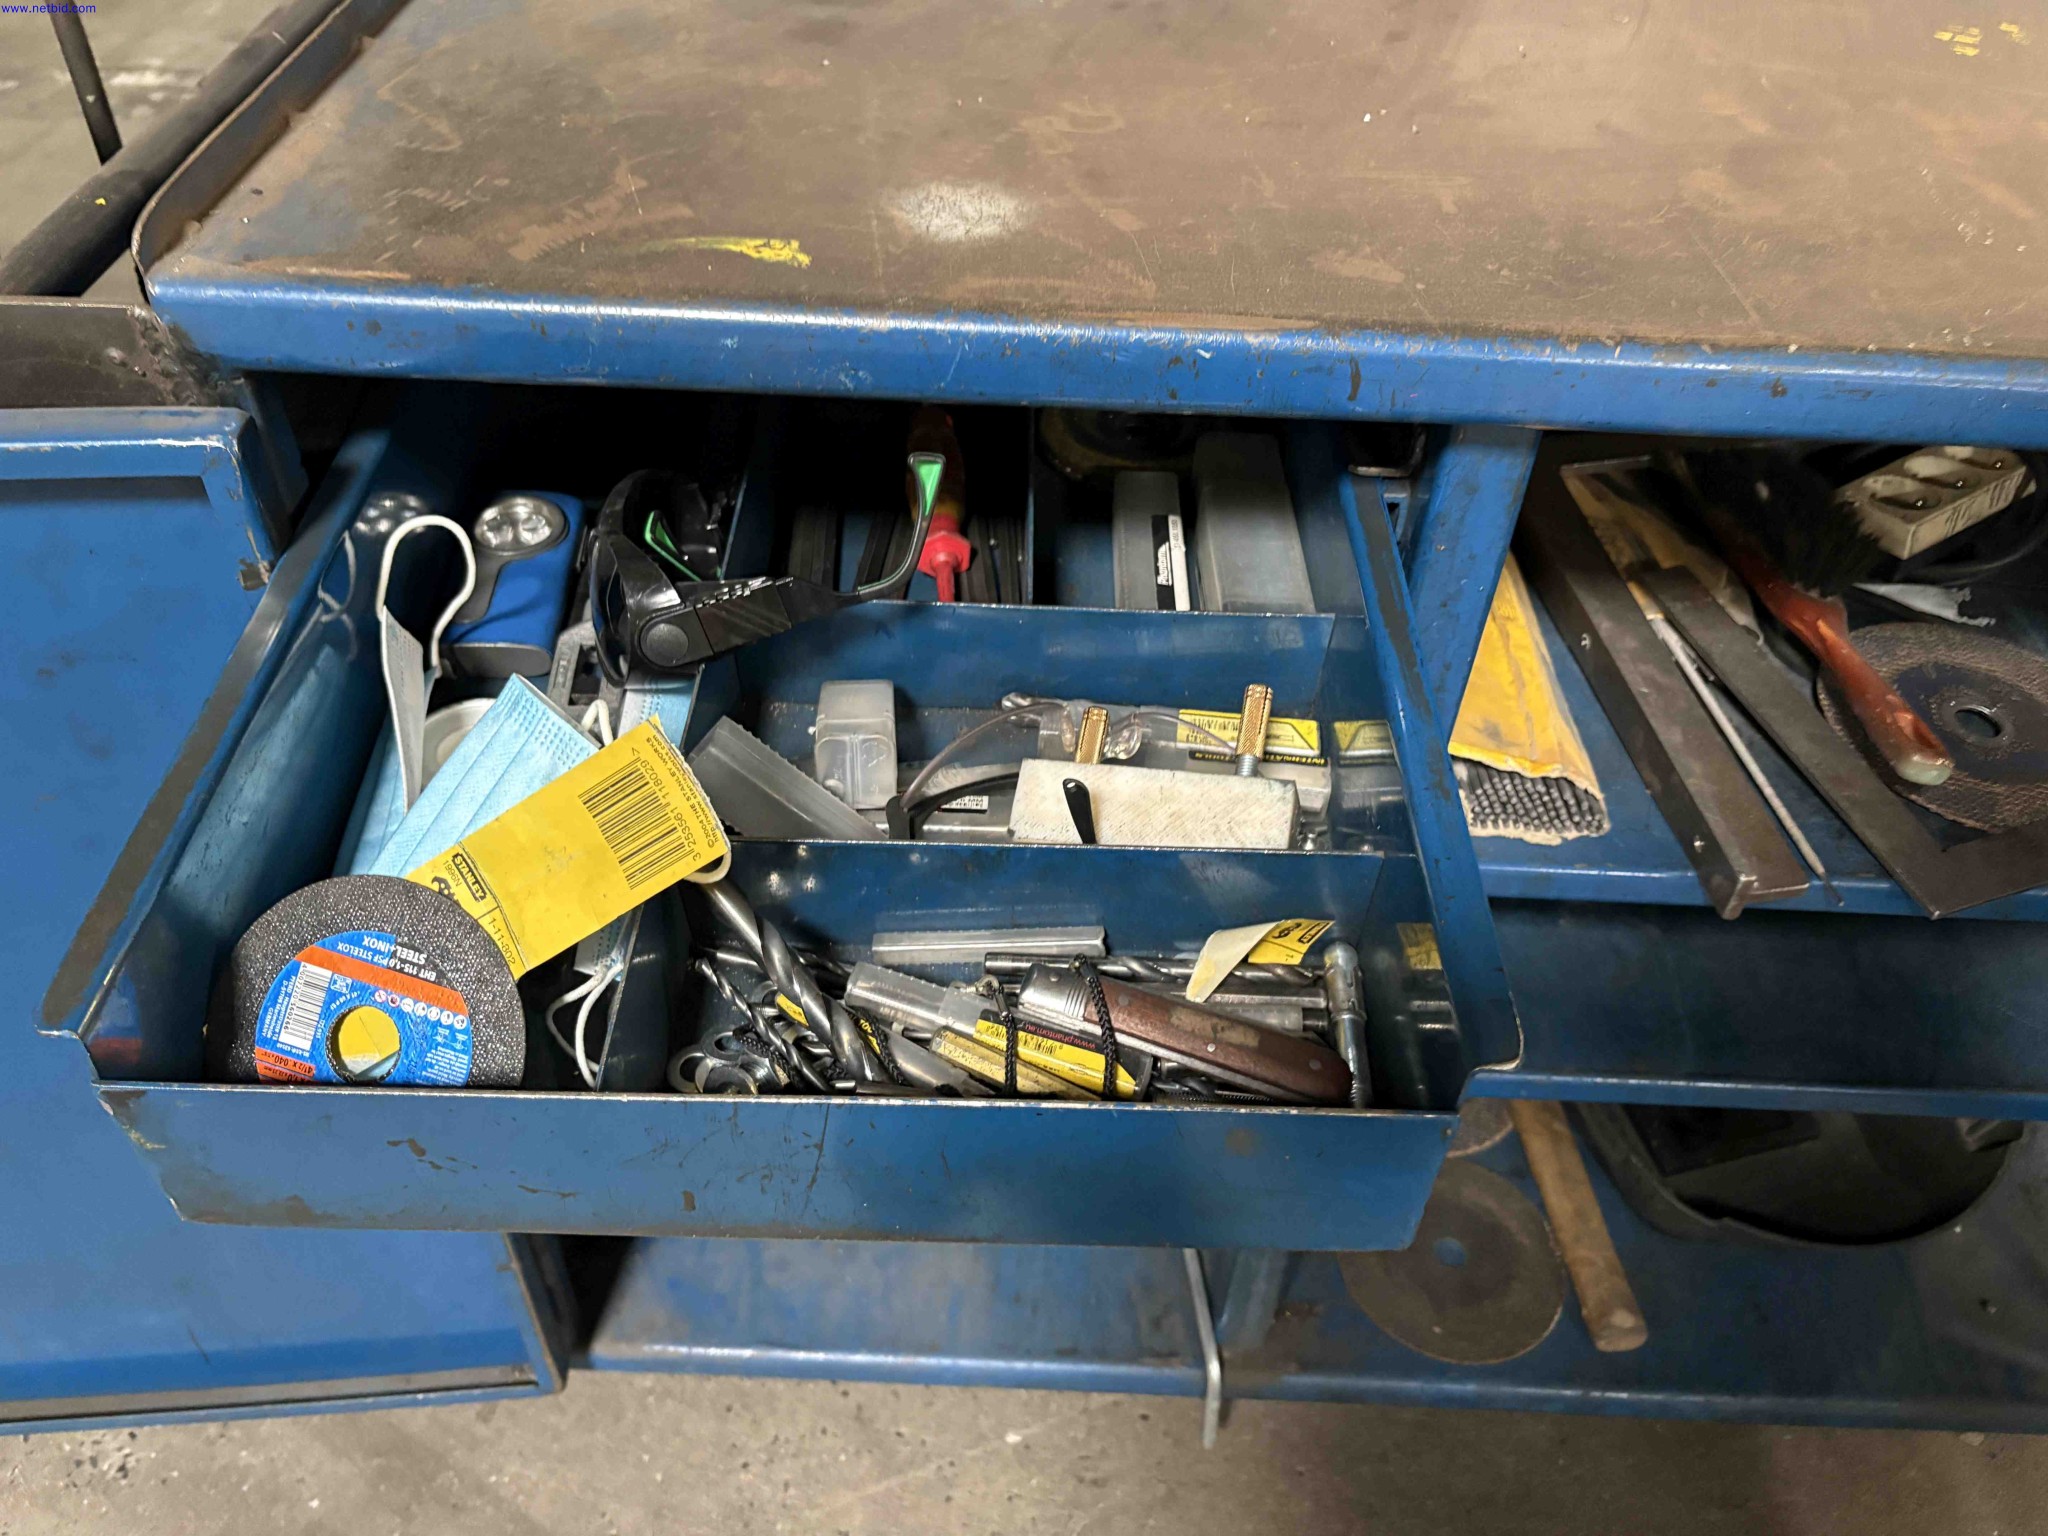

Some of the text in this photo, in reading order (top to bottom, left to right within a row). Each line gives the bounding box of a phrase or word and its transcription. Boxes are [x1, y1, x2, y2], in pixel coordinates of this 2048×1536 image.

[645, 734, 669, 767] WORKS
[665, 765, 692, 802] STANLEY
[639, 757, 702, 862] 3 253561 118029
[441, 859, 462, 887] 1996N
[452, 853, 485, 899] STANLEY
[336, 941, 373, 959] STEELOX
[361, 935, 427, 963] STEEL+INOX
[372, 951, 389, 964] PSF
[418, 967, 436, 981] EHT
[1024, 1022, 1095, 1050] www.phantom.eu
